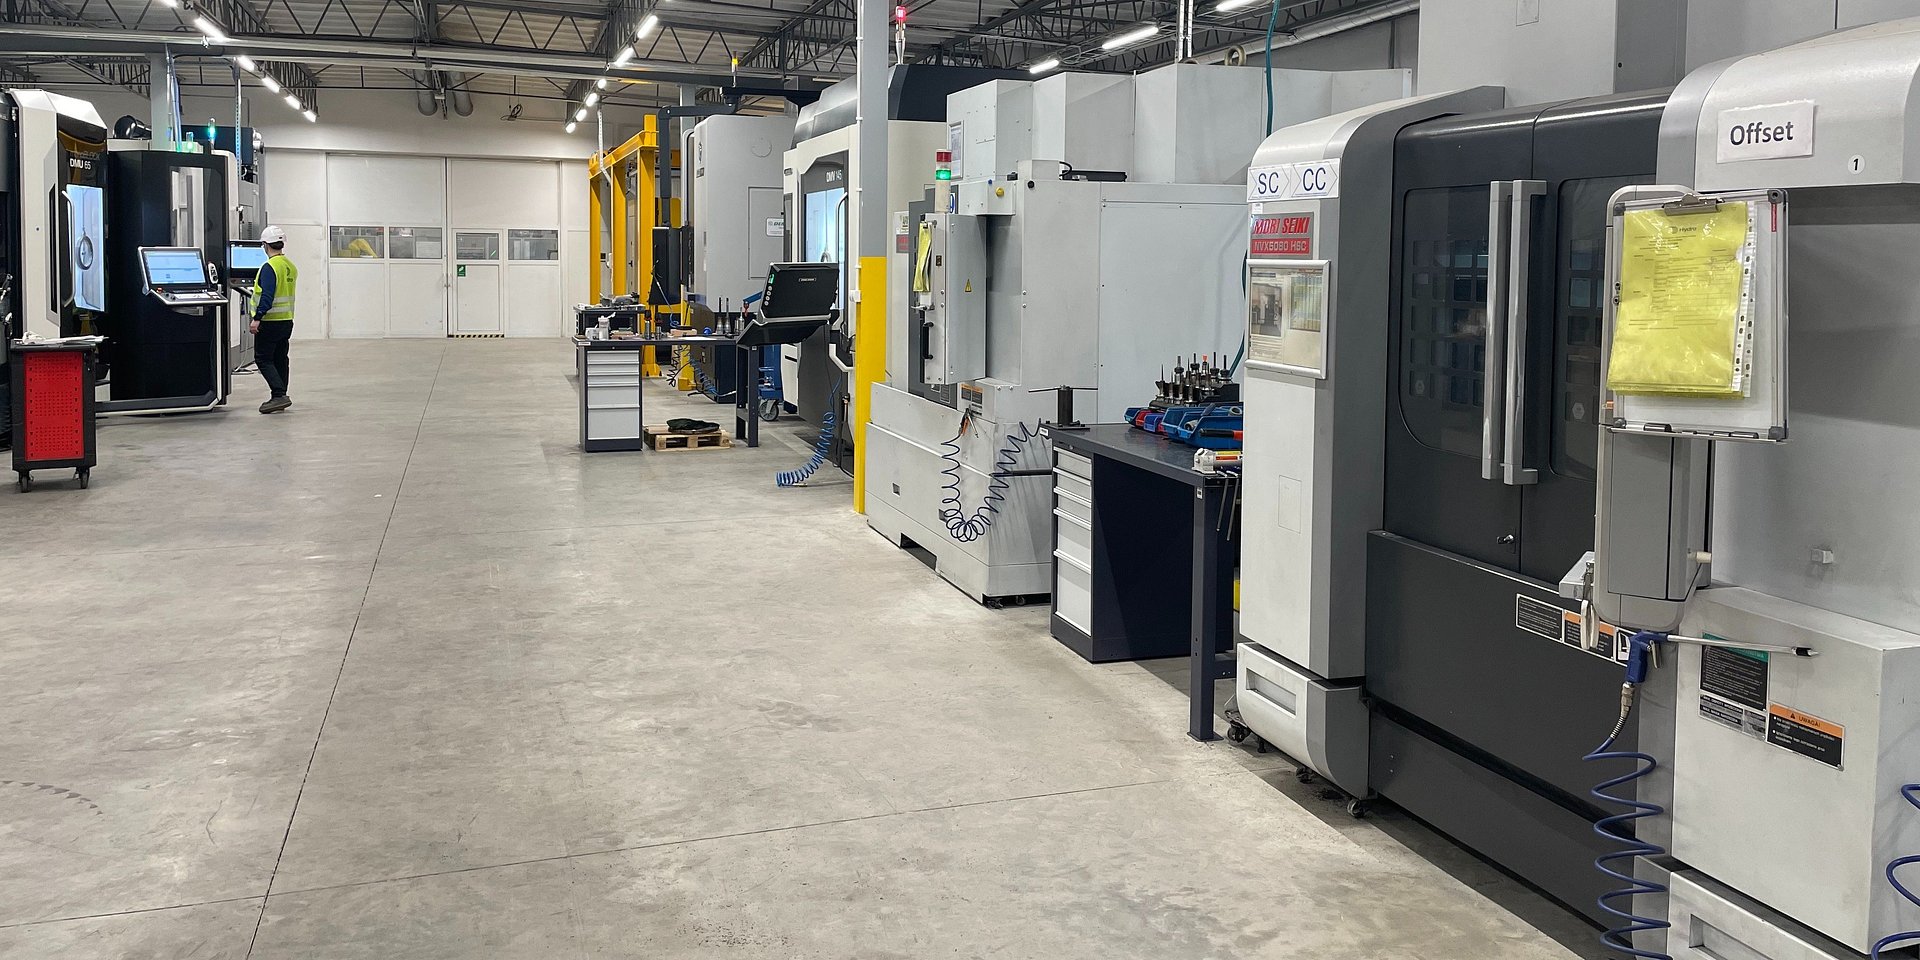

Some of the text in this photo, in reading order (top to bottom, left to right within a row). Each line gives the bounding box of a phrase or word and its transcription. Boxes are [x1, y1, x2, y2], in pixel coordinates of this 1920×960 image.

[1730, 121, 1794, 146] Offset
[1853, 158, 1859, 171] 1
[1258, 171, 1279, 195] SC
[1303, 167, 1326, 191] CC
[1253, 217, 1310, 235] MORI SEIKI
